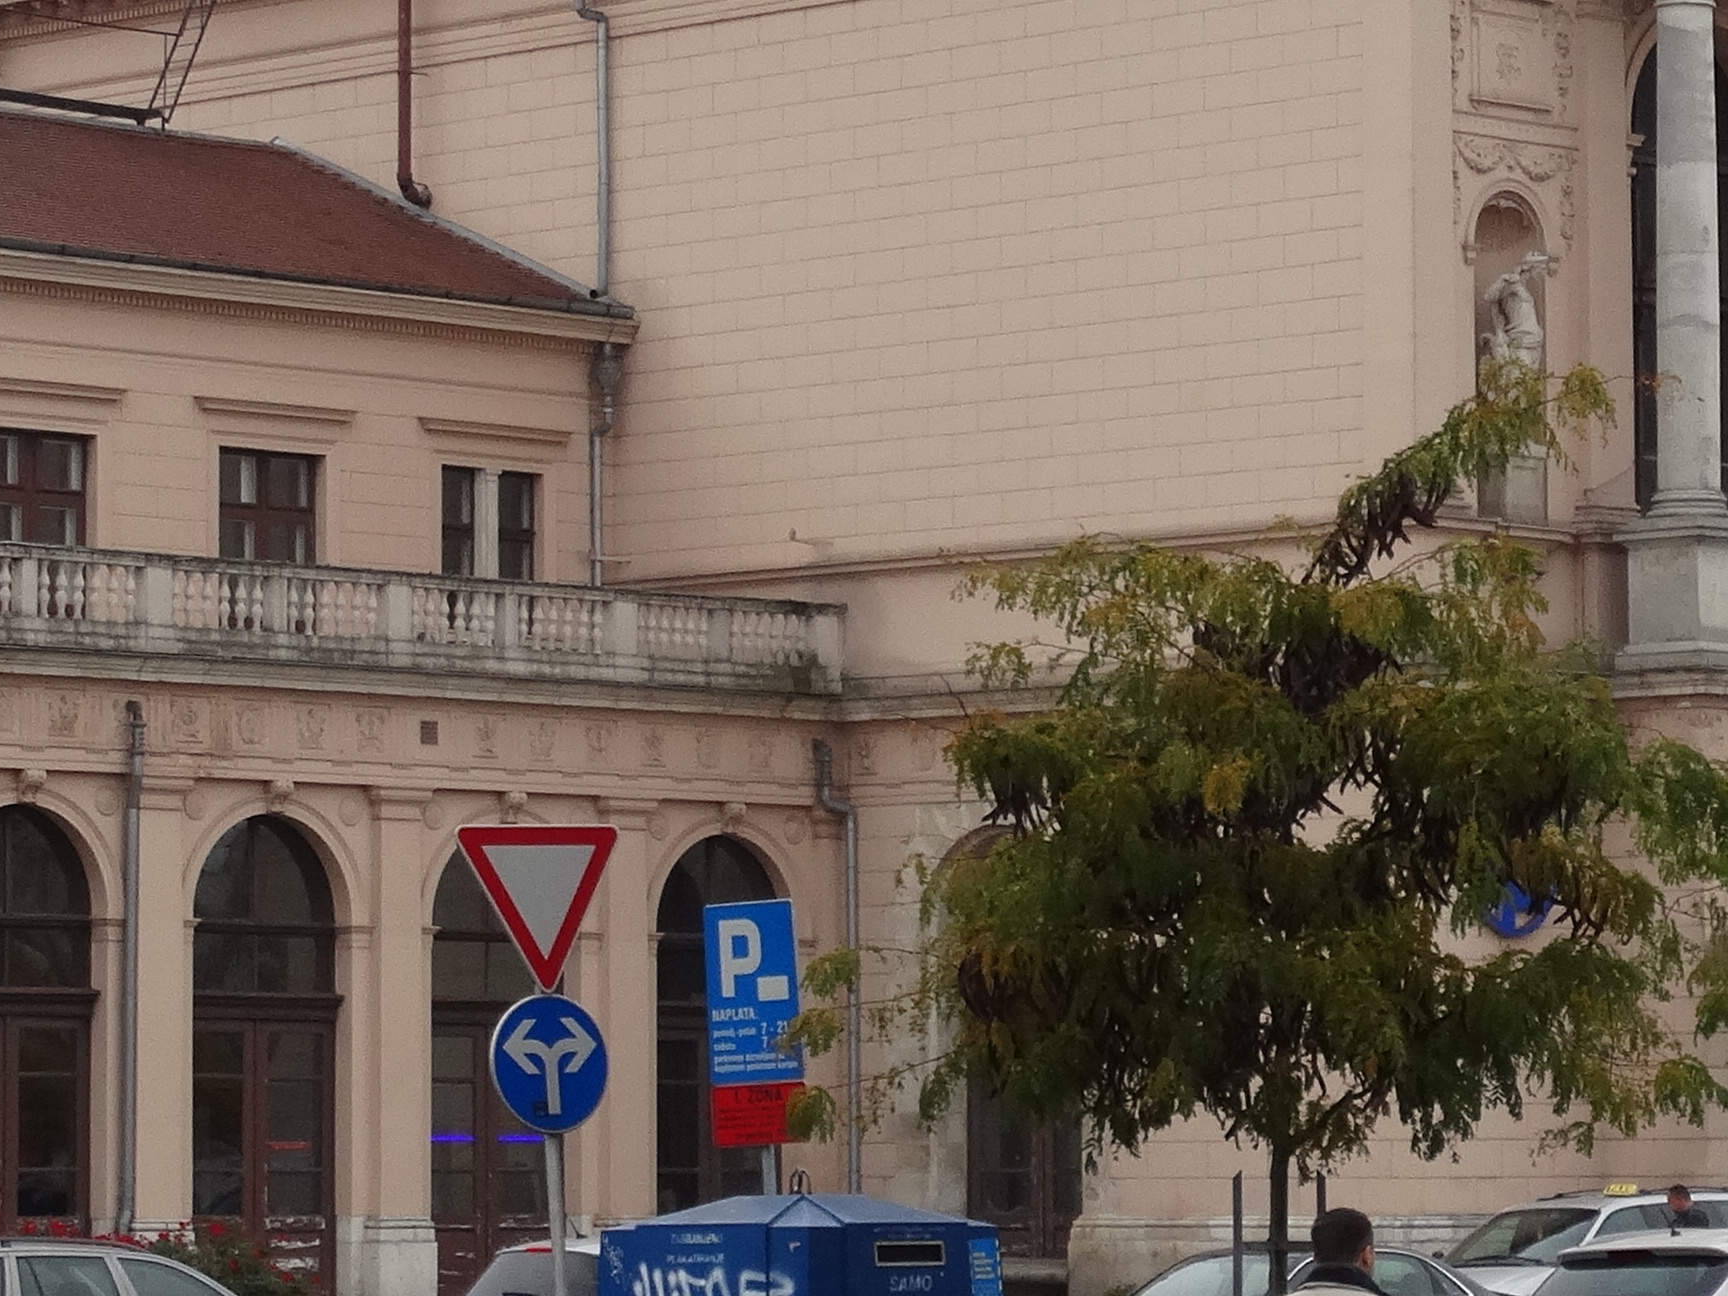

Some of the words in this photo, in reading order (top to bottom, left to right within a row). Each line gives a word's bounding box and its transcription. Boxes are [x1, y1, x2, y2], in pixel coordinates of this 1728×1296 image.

[718, 918, 762, 998] P
[760, 1022, 768, 1035] 7
[889, 1274, 933, 1292] SAMO
